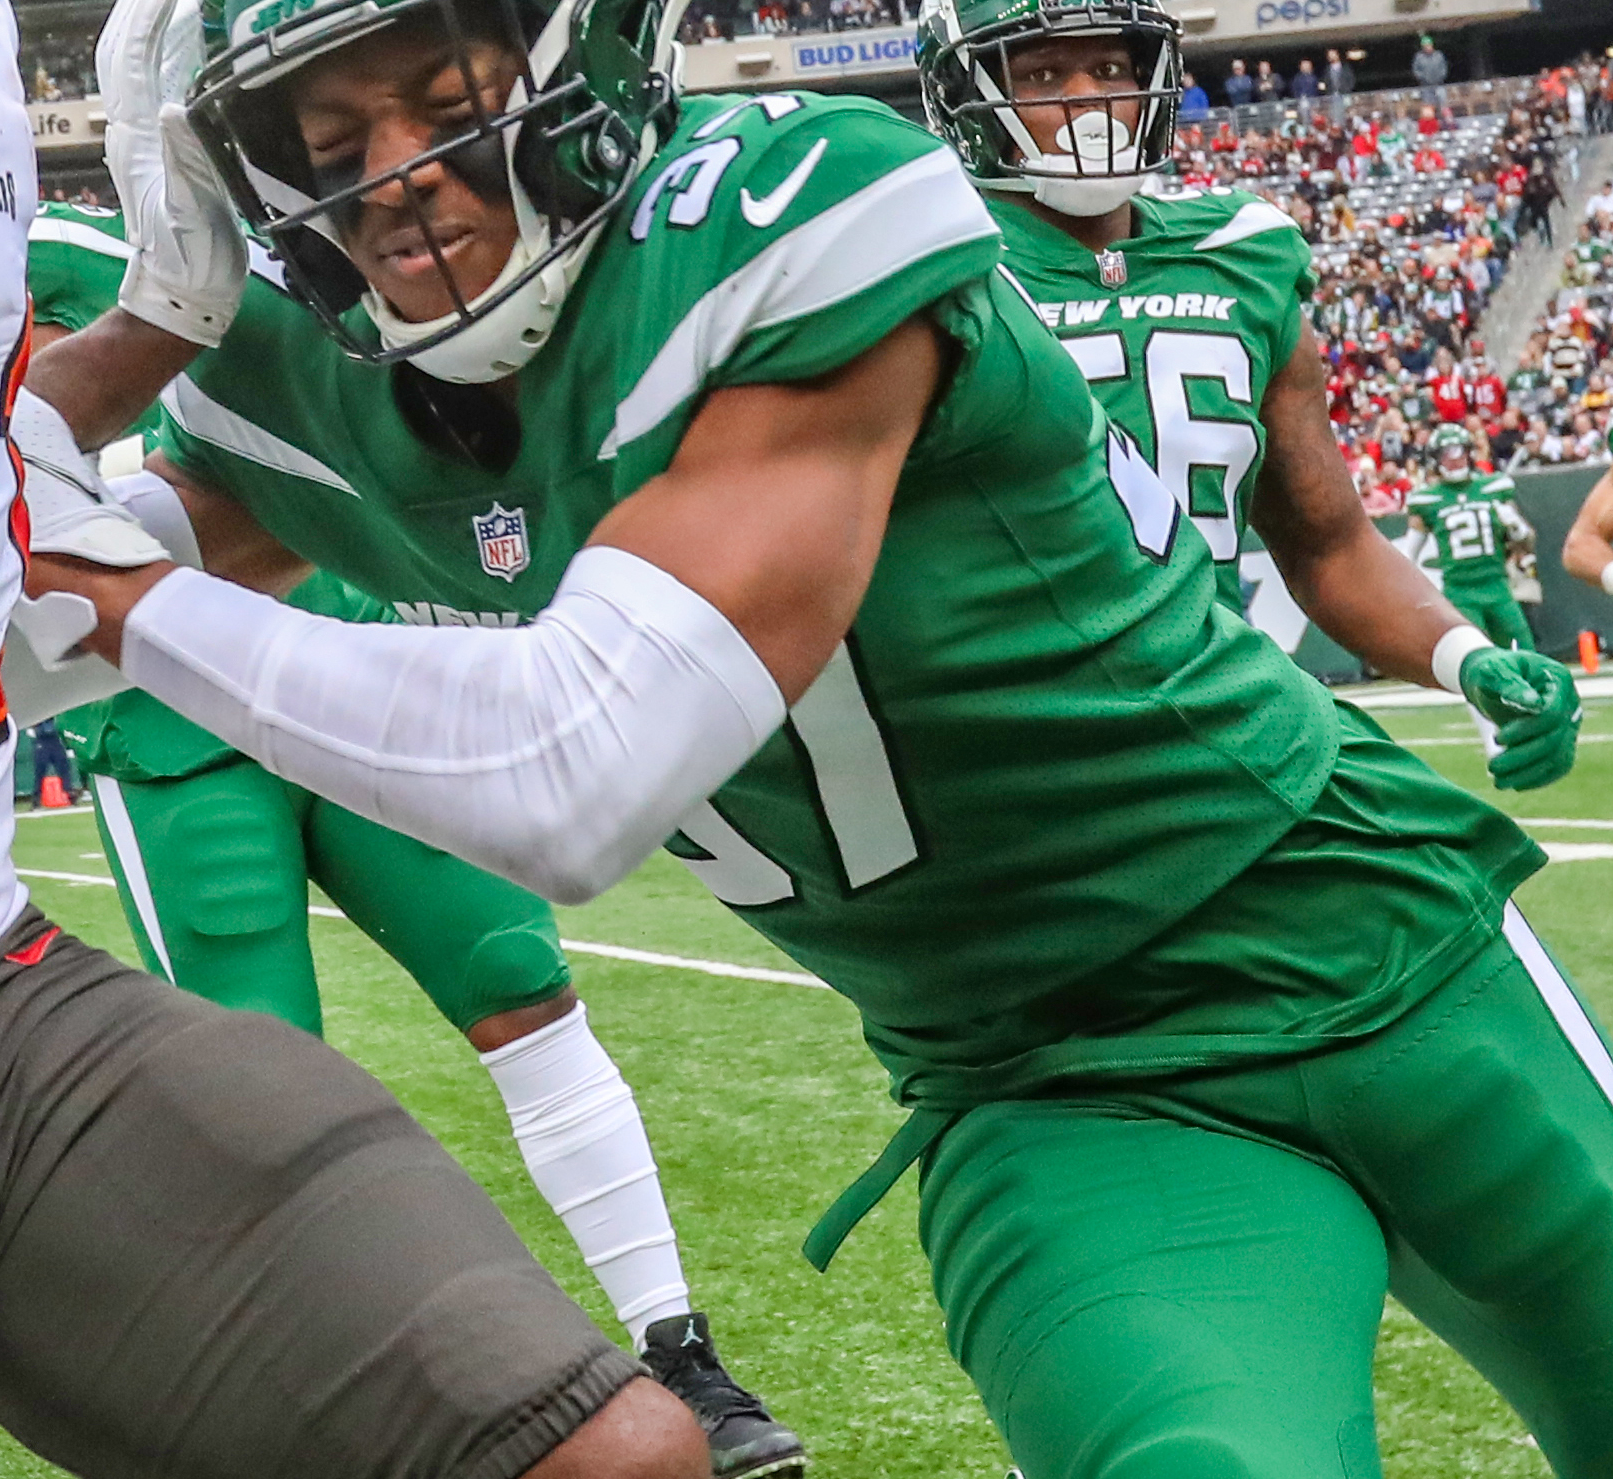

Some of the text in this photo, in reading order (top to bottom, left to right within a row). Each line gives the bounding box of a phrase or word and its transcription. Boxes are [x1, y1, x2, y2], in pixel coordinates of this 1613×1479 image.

[797, 35, 918, 71] BUD LIGH
[1104, 267, 1125, 282] NFL
[1038, 293, 1237, 327] EW YORK
[1446, 509, 1495, 559] 21
[486, 538, 523, 567] NFL
